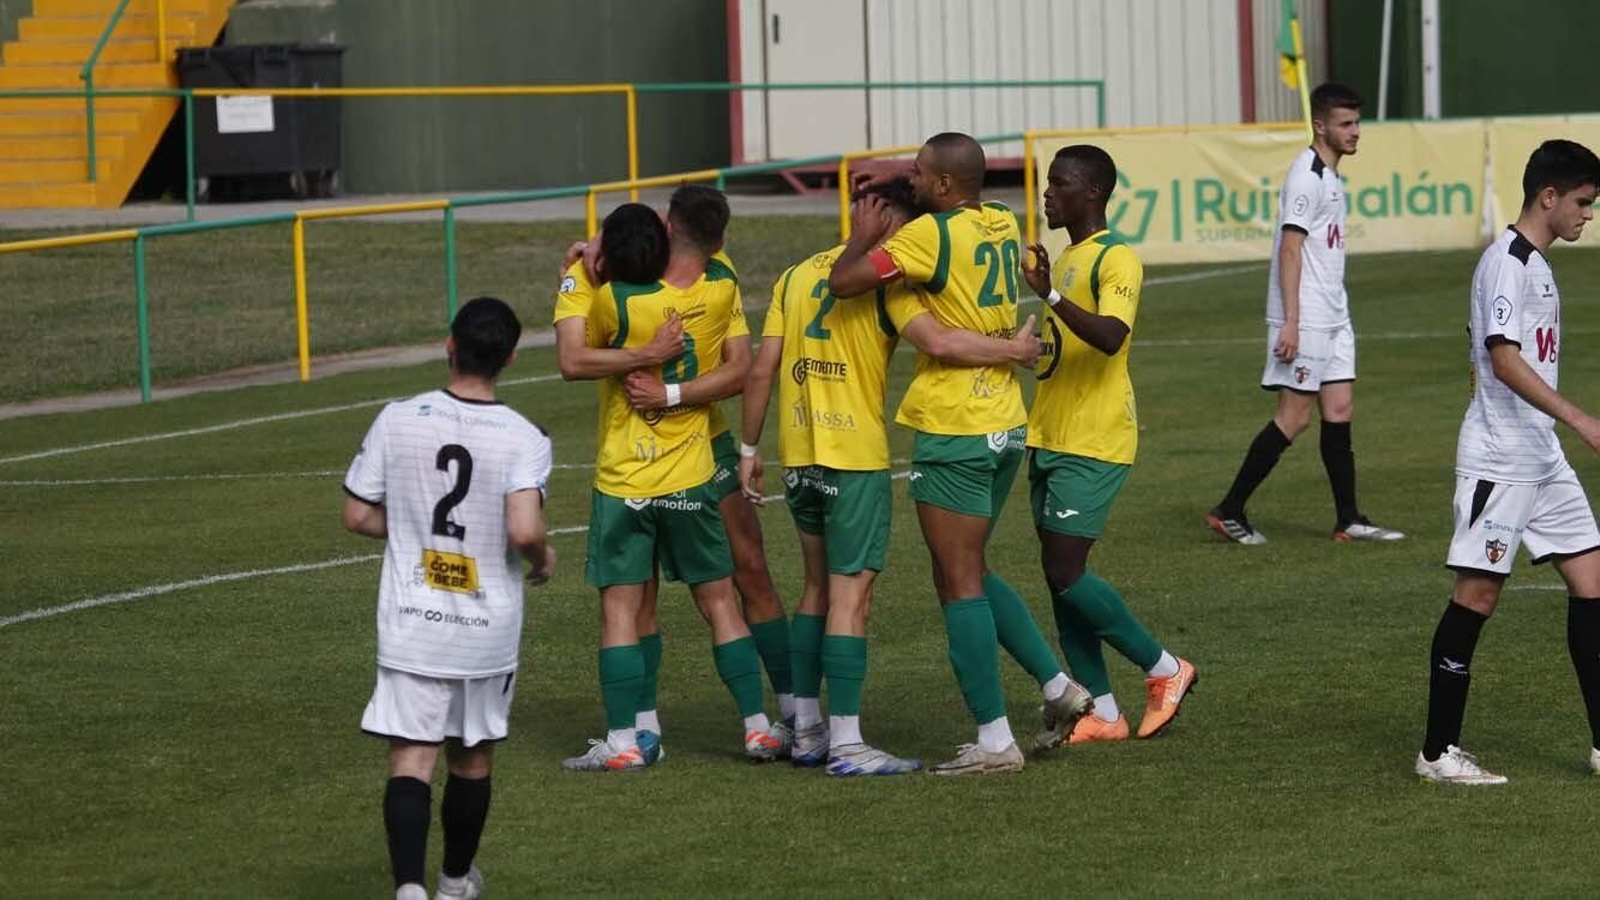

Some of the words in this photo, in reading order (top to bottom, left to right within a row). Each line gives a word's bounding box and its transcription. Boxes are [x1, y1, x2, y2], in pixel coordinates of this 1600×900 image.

[1194, 177, 1282, 222] Rui
[975, 239, 1019, 307] 20
[806, 279, 837, 340] 2
[432, 444, 473, 542] 2
[652, 499, 701, 511] emotion
[431, 561, 469, 575] COME
[434, 573, 469, 588] BEBE
